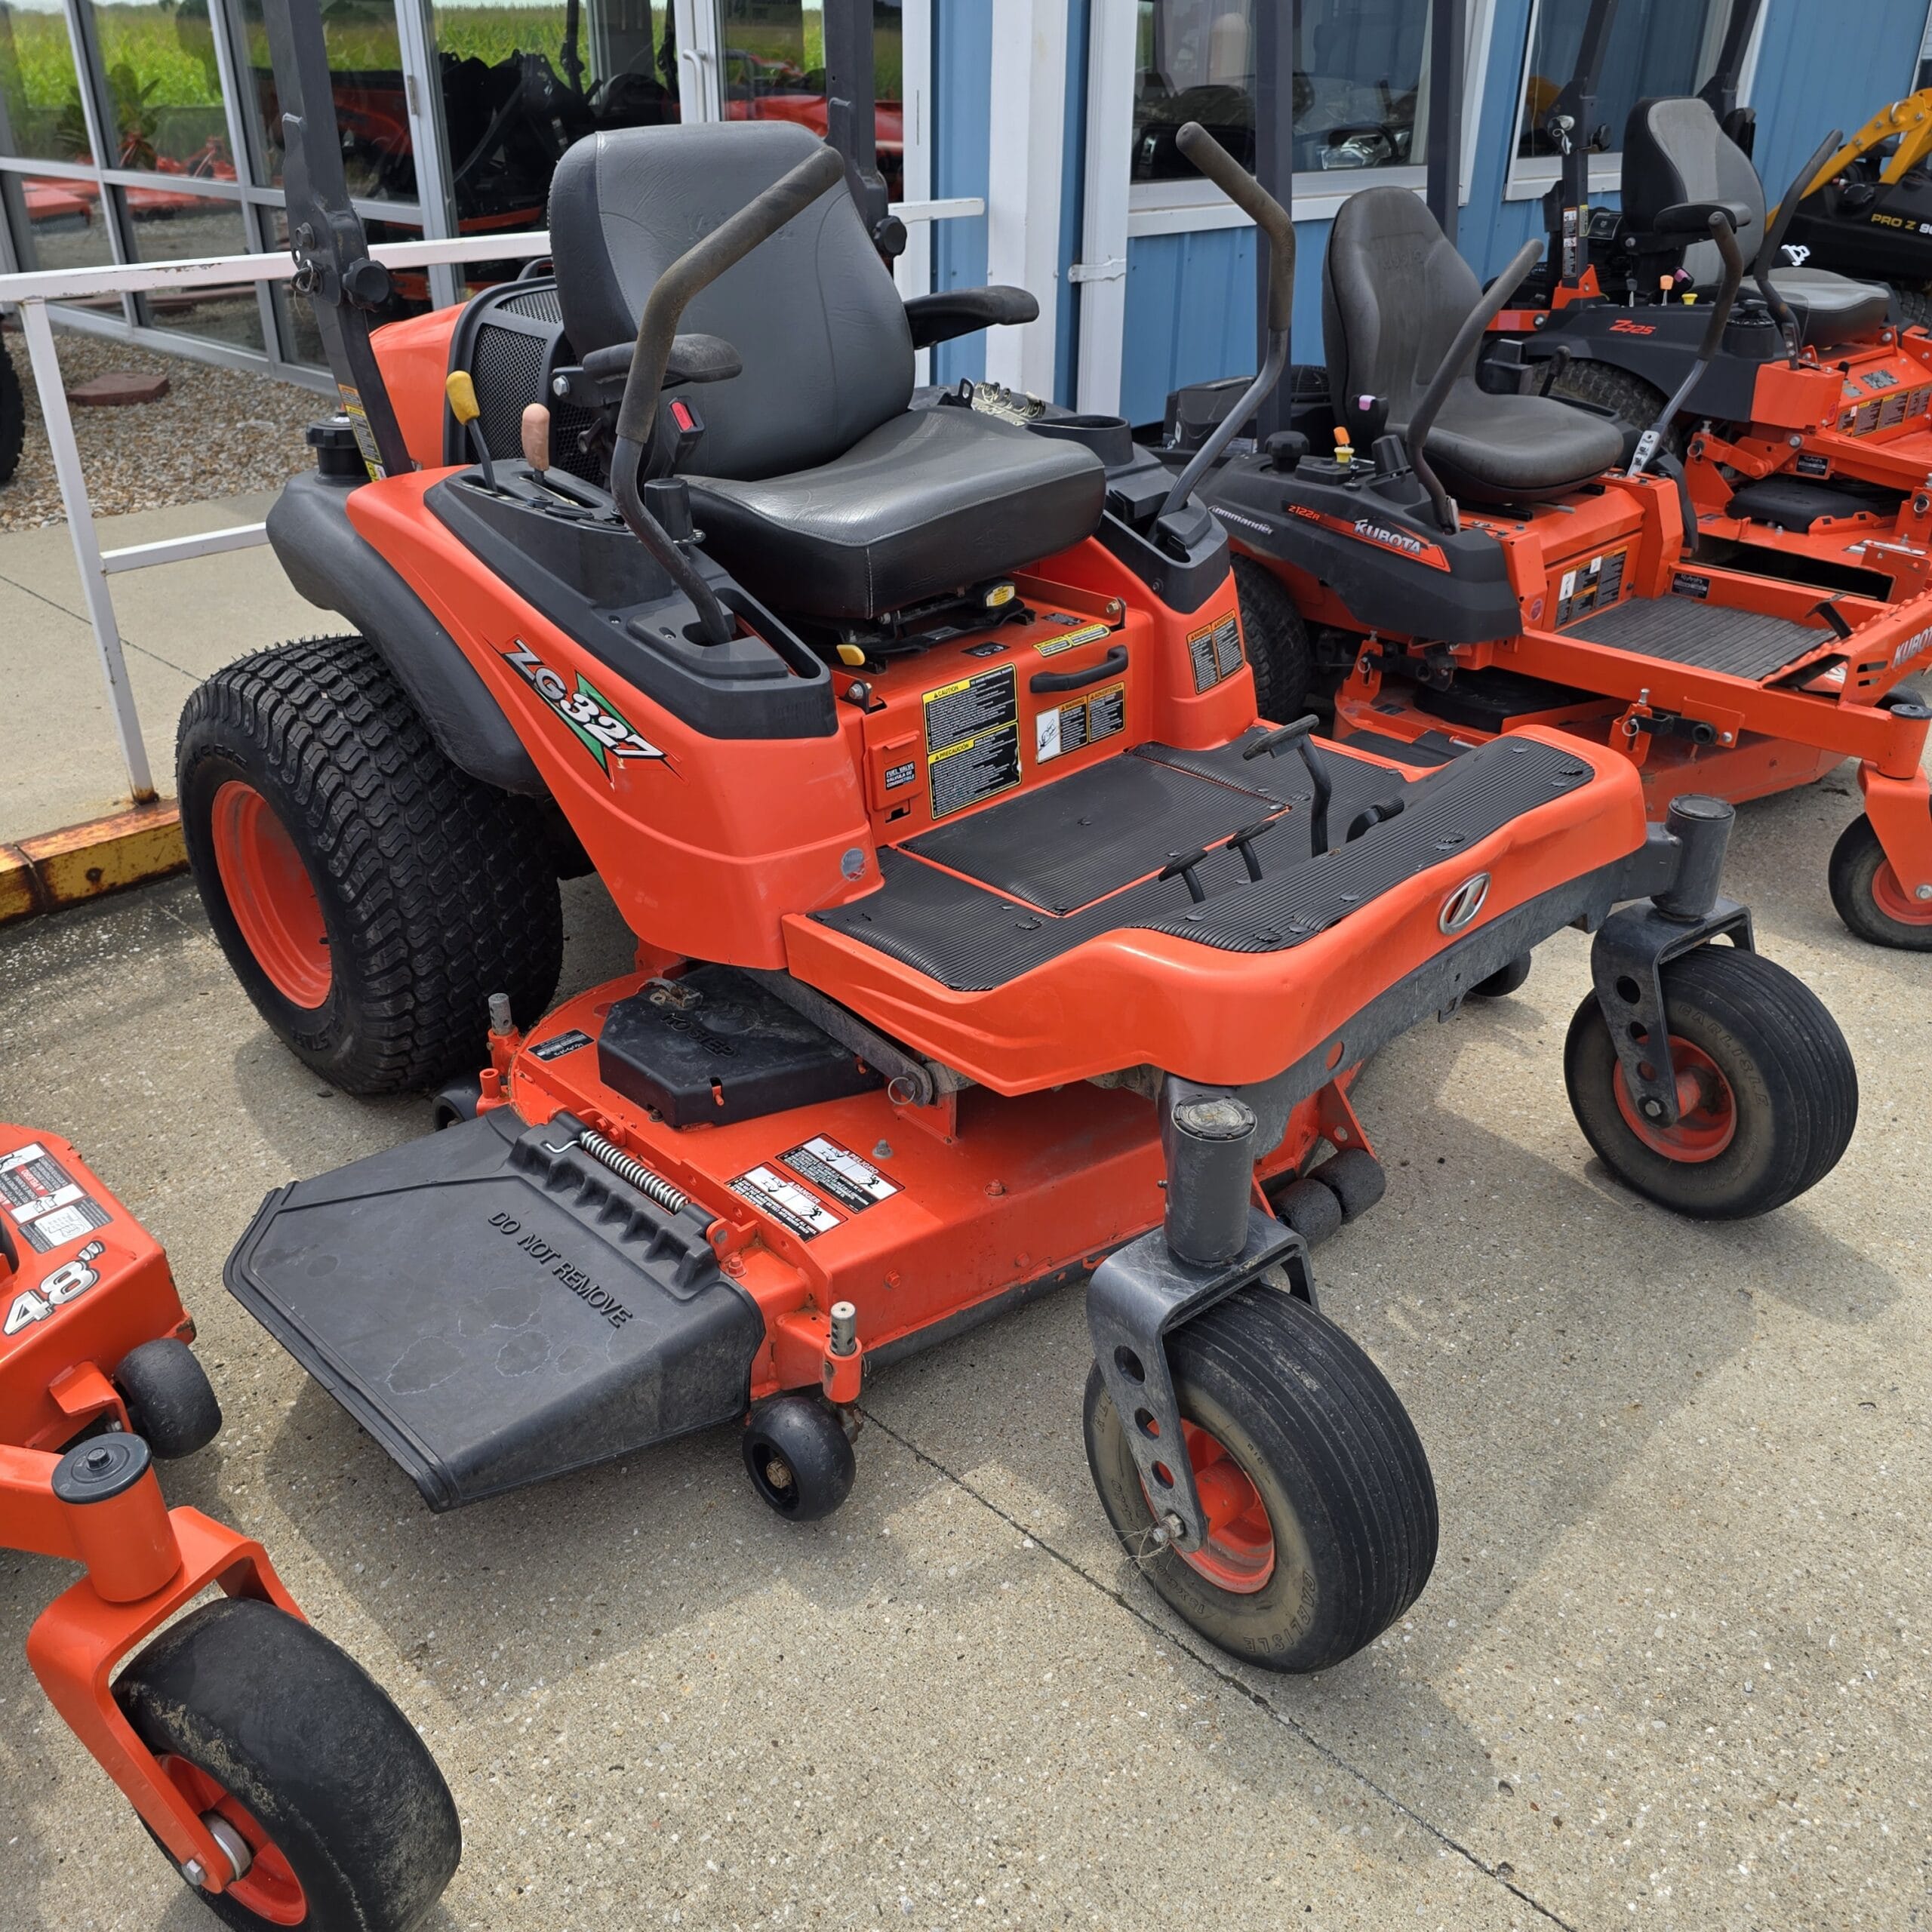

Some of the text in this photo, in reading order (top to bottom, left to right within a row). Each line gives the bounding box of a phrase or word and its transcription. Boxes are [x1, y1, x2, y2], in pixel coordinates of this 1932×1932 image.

[1871, 214, 1903, 228] PRO
[1904, 220, 1917, 230] Z
[1354, 518, 1421, 555] KUBOTA
[501, 638, 666, 758] ZG327
[938, 685, 959, 697] CAUTION
[1678, 1004, 1769, 1106] CARLISLE
[850, 1153, 879, 1174] PELIGRO
[21, 1170, 41, 1189] PELIGRO
[793, 1185, 821, 1204] DANGER
[488, 1211, 633, 1329] DO NOT REMOVE
[1244, 1571, 1317, 1654] CARLISLE
